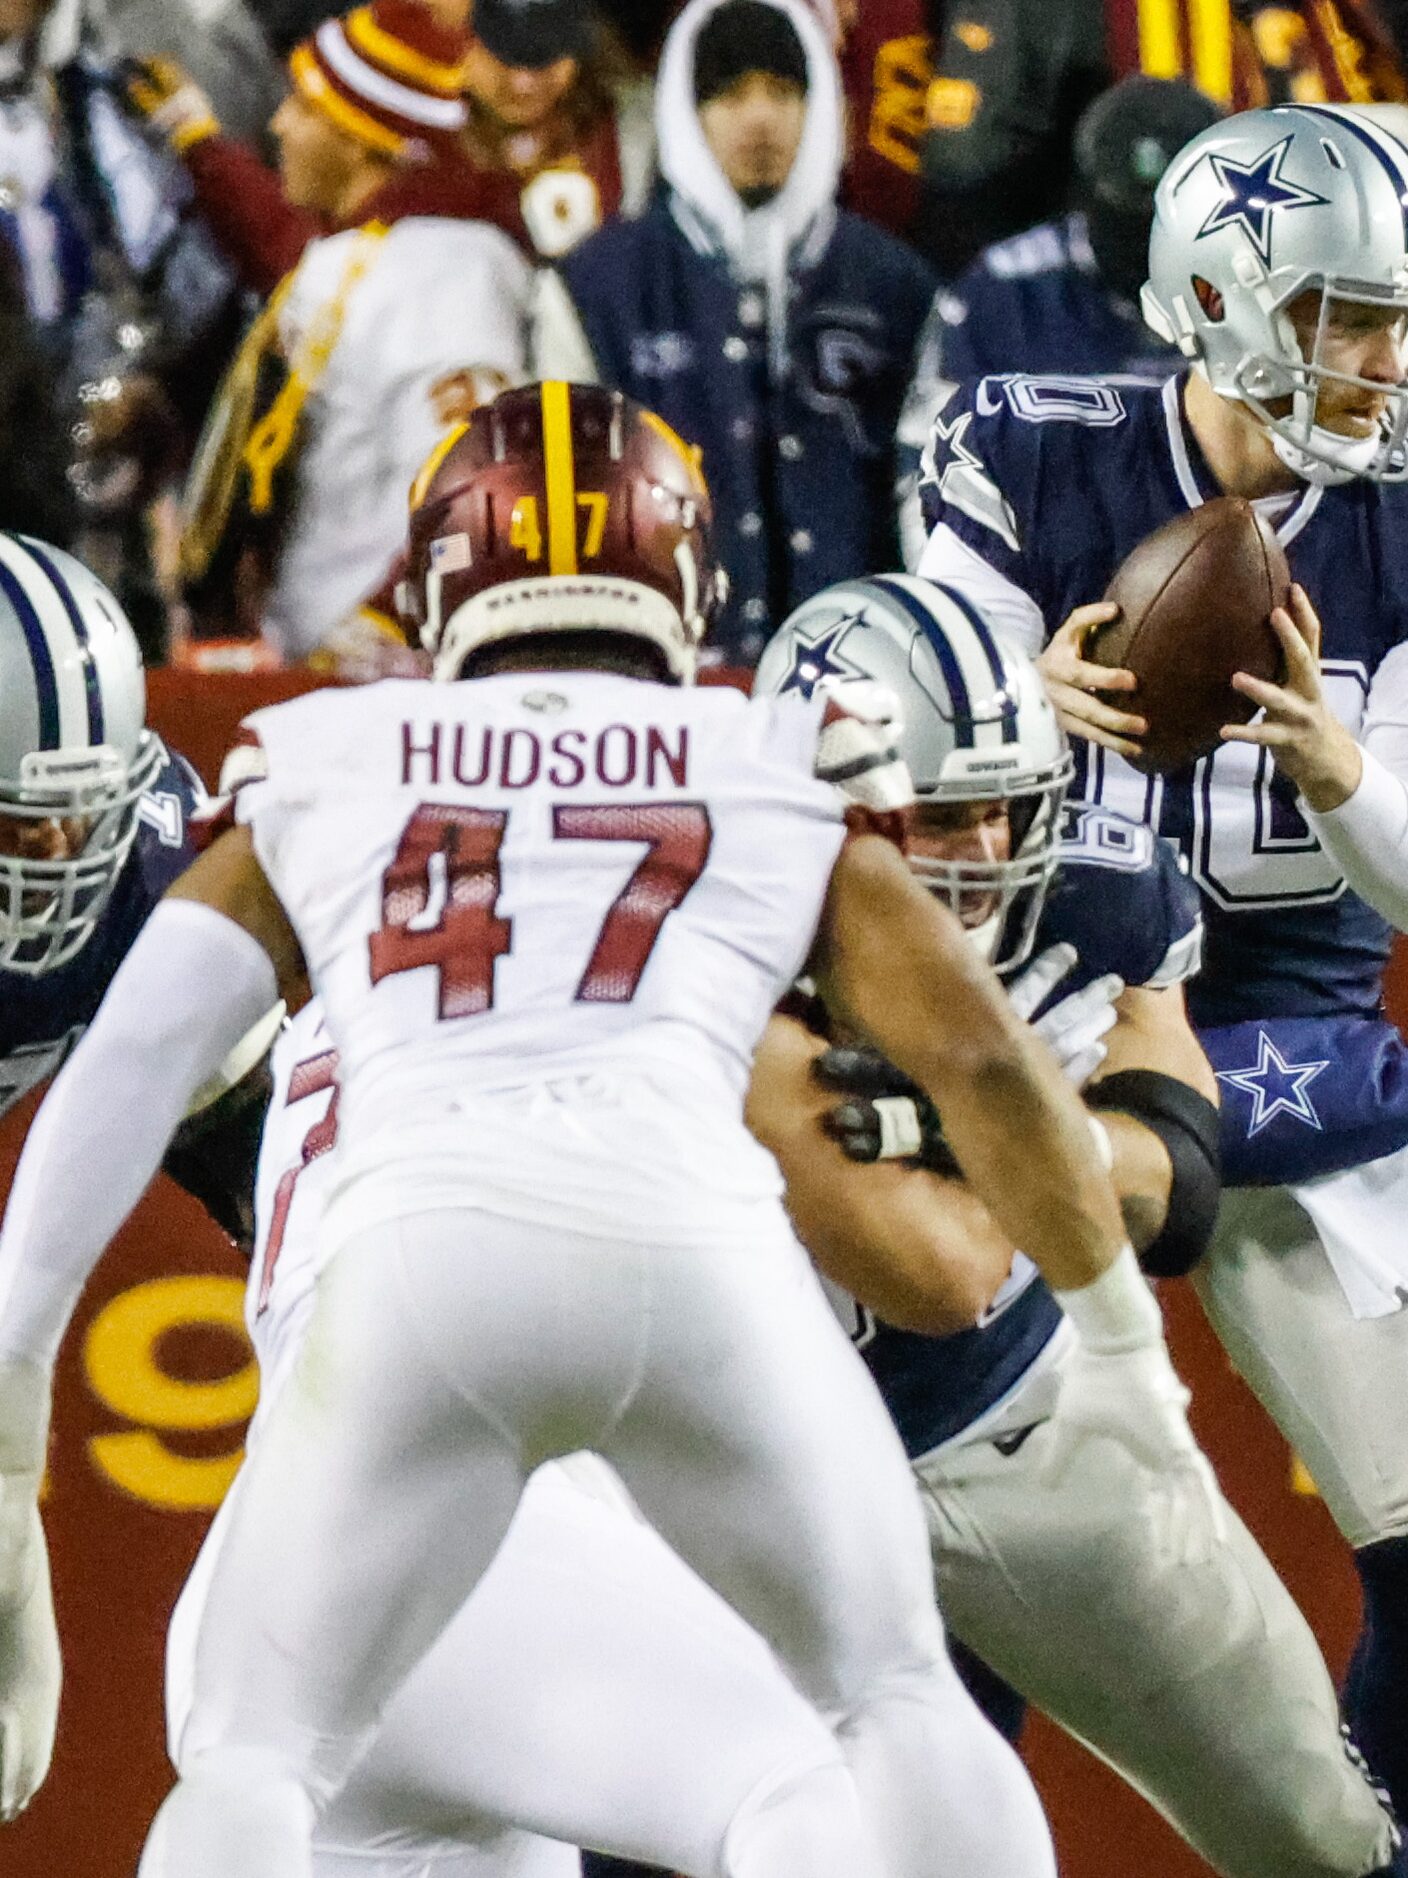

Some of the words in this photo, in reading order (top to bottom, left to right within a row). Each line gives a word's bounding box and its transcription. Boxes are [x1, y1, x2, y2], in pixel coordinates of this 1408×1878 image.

[509, 490, 609, 562] 47
[401, 721, 690, 790] HUDSON
[368, 802, 714, 1022] 47
